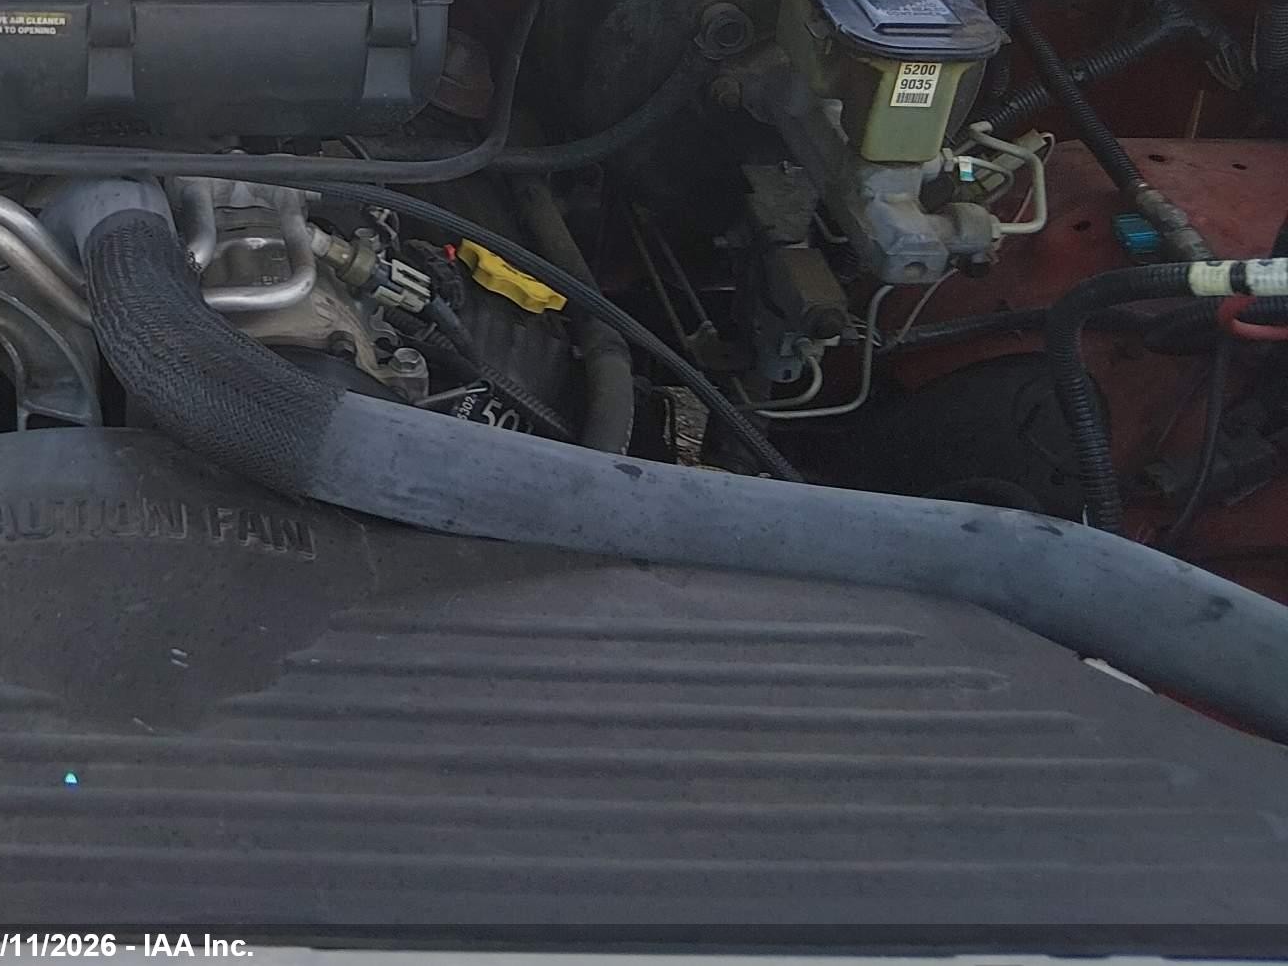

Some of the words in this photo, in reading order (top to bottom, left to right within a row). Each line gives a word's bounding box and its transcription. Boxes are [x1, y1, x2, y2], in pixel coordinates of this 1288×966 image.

[26, 17, 66, 26] CLEANER
[4, 26, 17, 34] TO
[17, 26, 57, 35] OPENING
[903, 64, 937, 76] 5200
[899, 78, 933, 91] 9035
[206, 506, 316, 561] FAN
